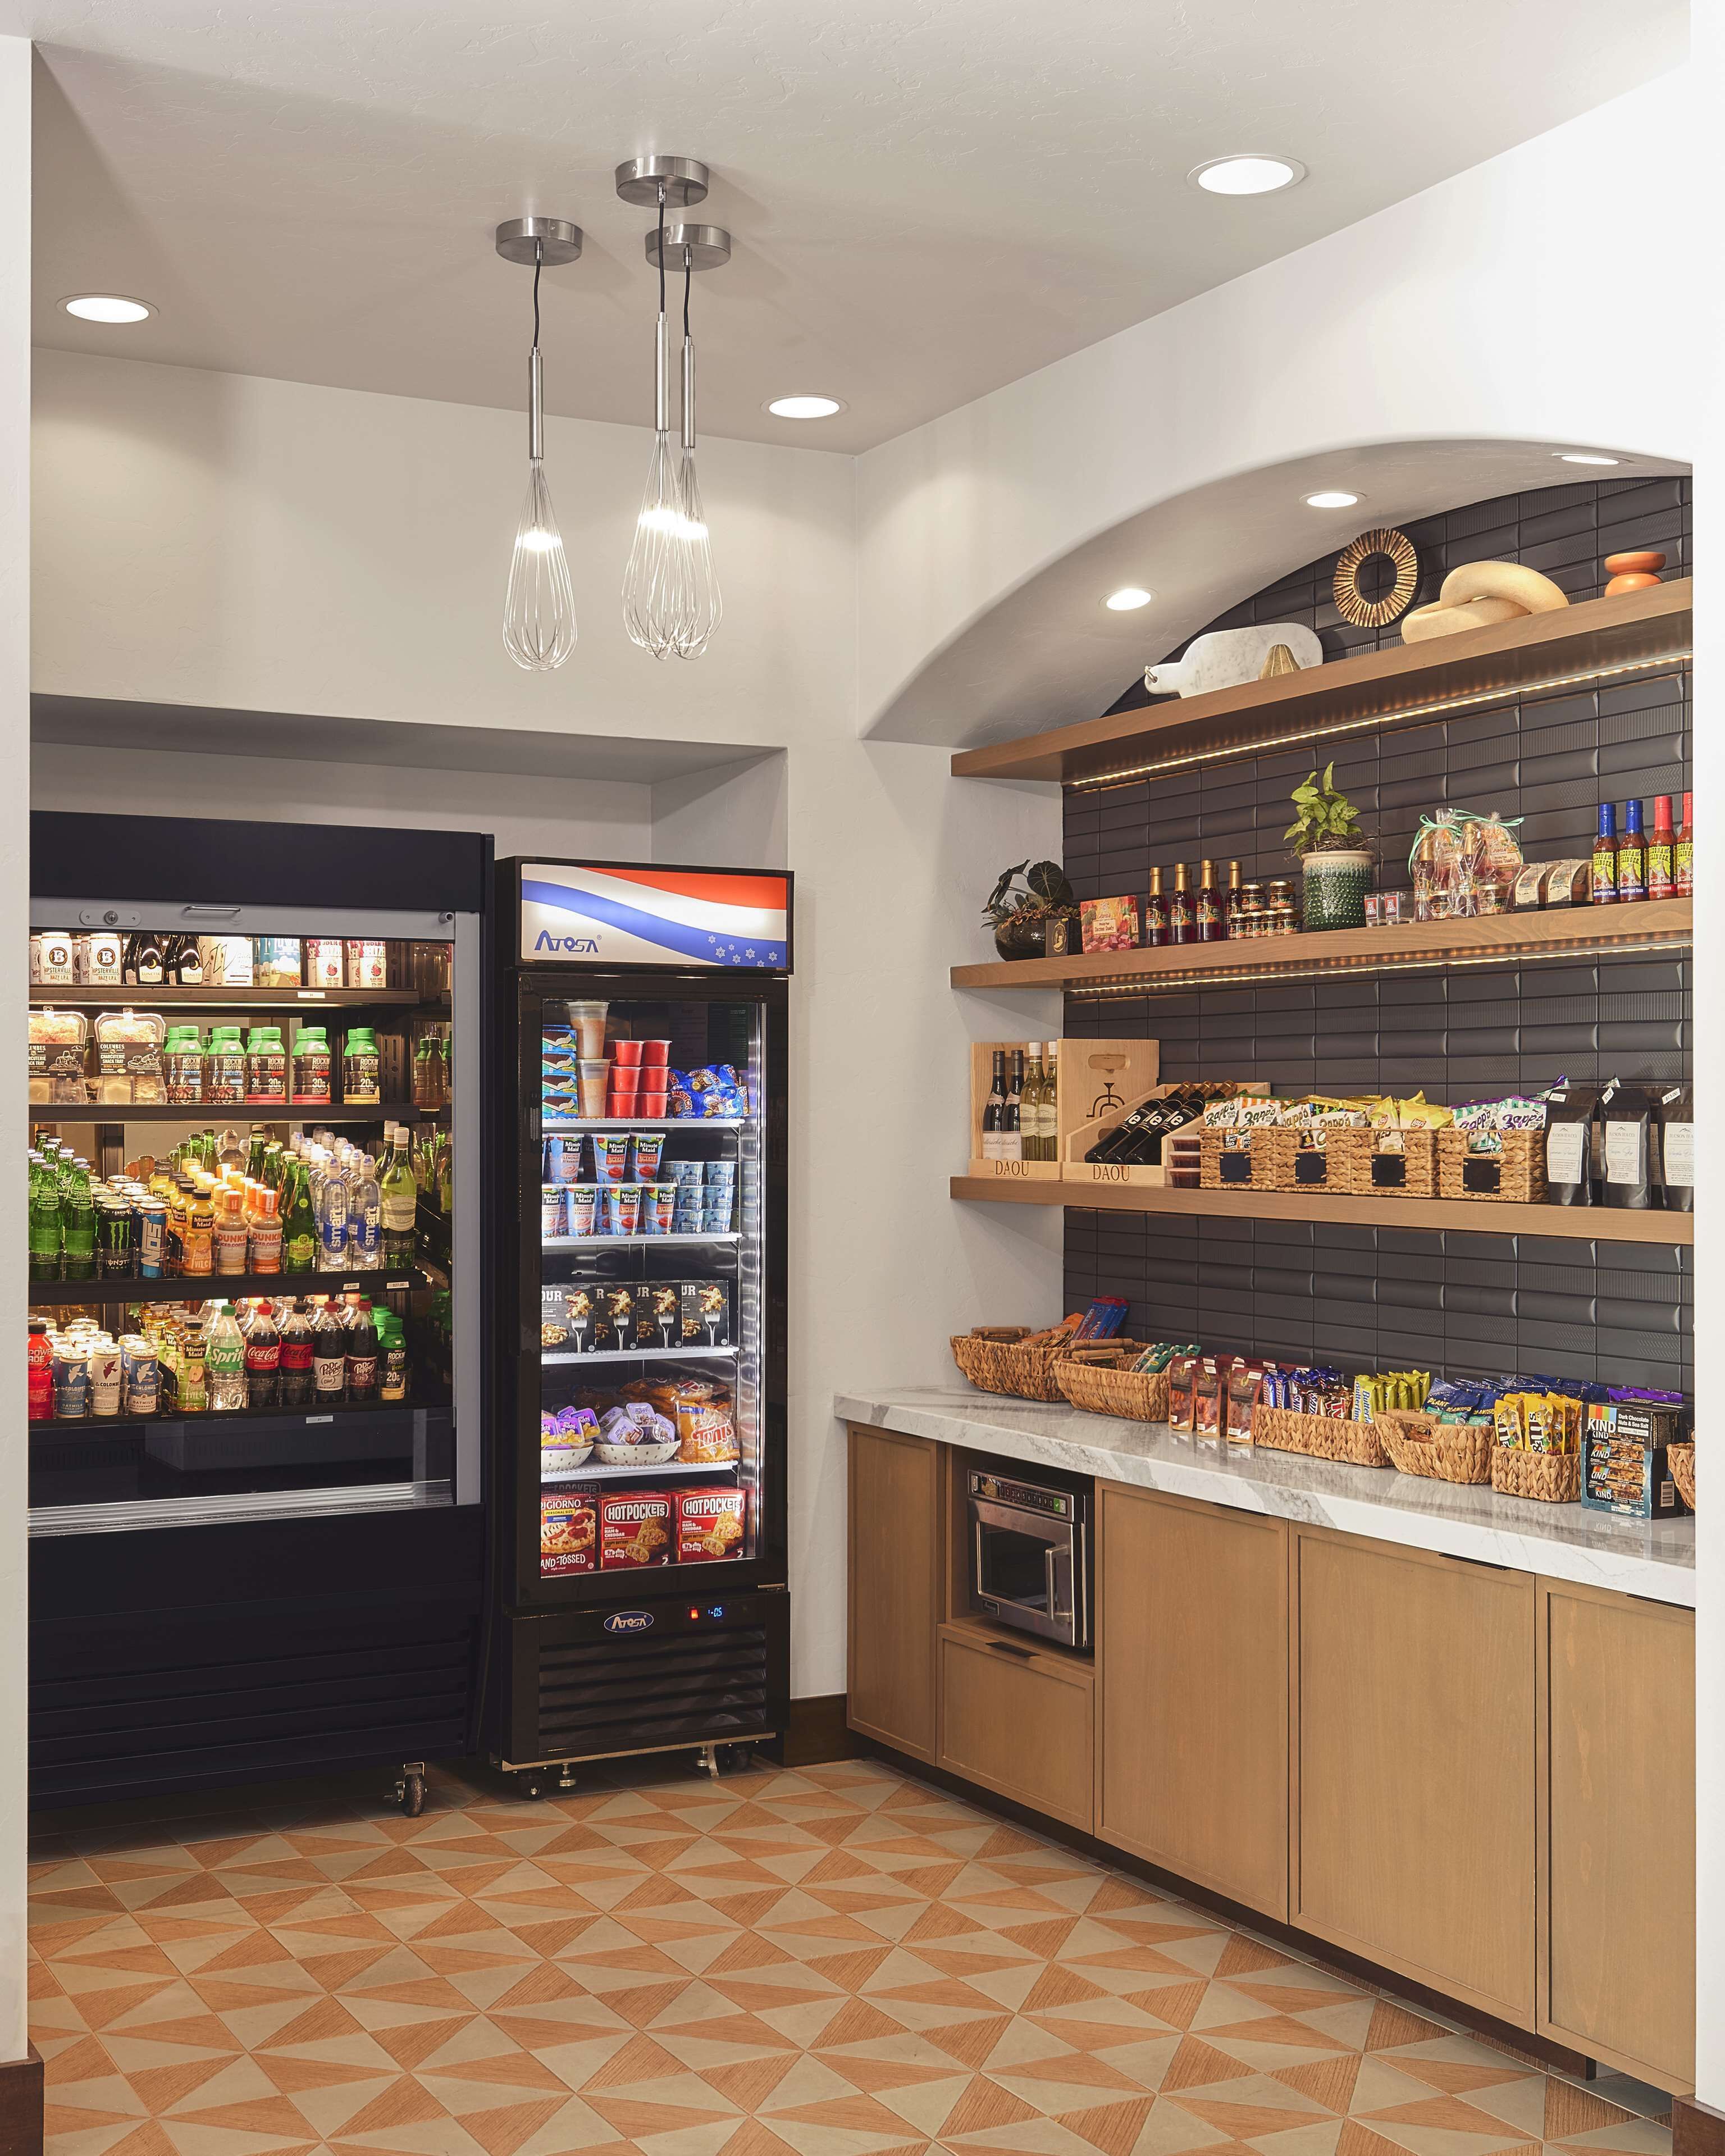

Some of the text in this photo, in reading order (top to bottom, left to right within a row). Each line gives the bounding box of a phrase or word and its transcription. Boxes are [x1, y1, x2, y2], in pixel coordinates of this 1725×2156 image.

[1367, 901, 1376, 914] A
[1386, 899, 1395, 913] A
[996, 1160, 1029, 1176] DAOU
[1093, 1165, 1130, 1181] DAOU
[330, 1207, 341, 1248] smart
[364, 1206, 376, 1246] smart
[320, 1364, 342, 1375] Pepper
[354, 1364, 374, 1374] Pepper
[1427, 1397, 1450, 1407] PLANT
[1628, 1415, 1649, 1423] Chocolate
[1587, 1419, 1616, 1433] KIND
[1591, 1450, 1610, 1458] KIND
[1591, 1471, 1607, 1480] KIND
[1595, 1490, 1612, 1499] KIND
[541, 1554, 586, 1570] AND-TOSSED
